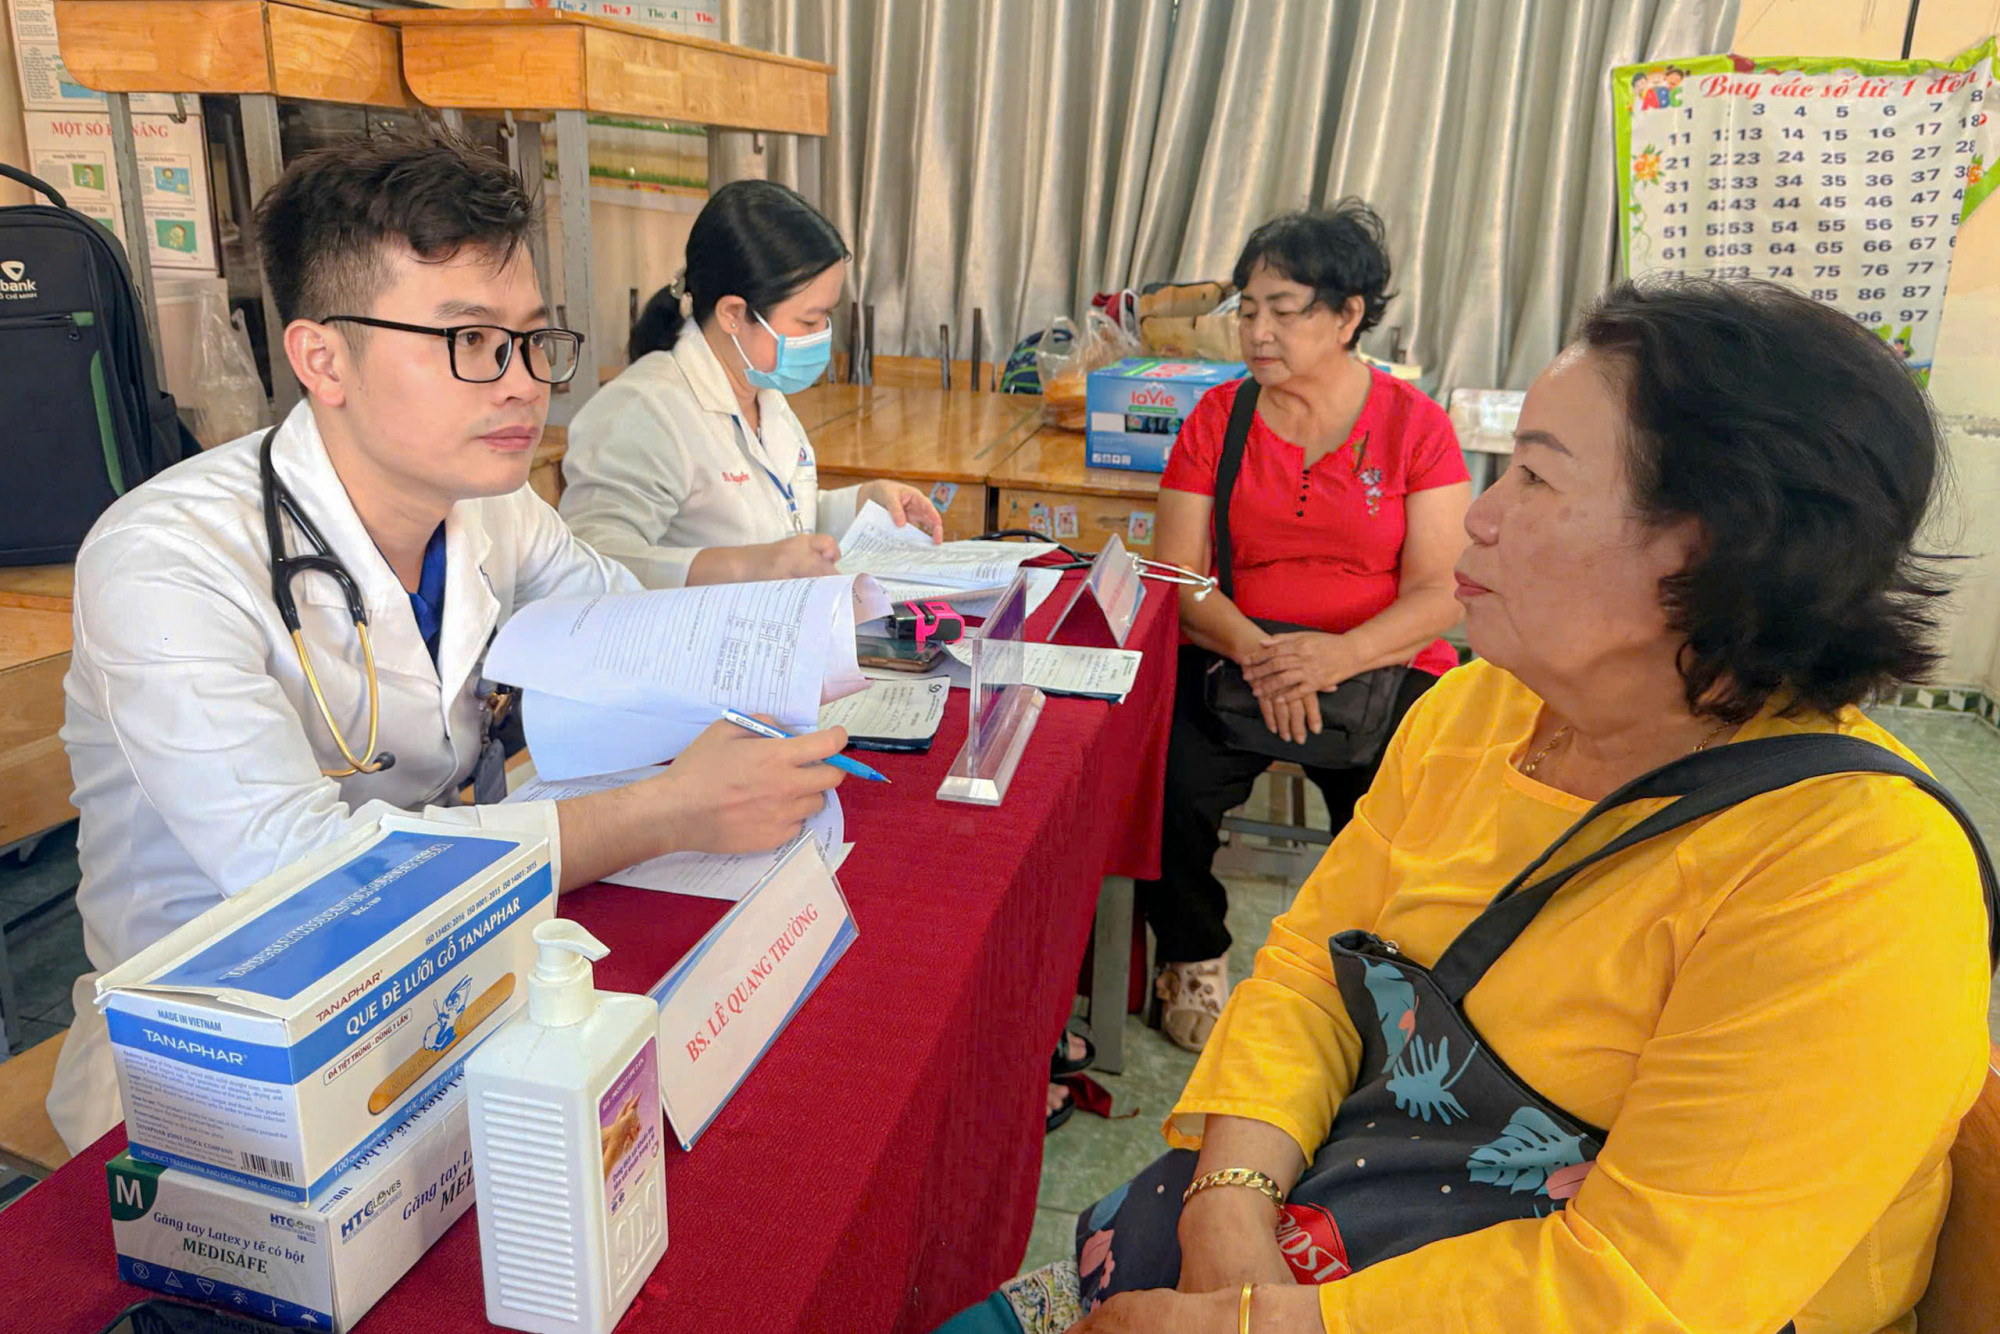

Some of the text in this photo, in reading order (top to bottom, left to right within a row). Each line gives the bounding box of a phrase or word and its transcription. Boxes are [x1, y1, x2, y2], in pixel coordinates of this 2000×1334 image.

[1641, 87, 1683, 111] ABC
[1902, 79, 1916, 97] 1
[1684, 90, 1983, 120] 1 3 4 5 6 7 8
[1669, 132, 1690, 145] 11
[1737, 128, 1762, 140] 13
[1782, 128, 1804, 139] 14
[1822, 129, 1848, 141] 15
[1869, 128, 1896, 139] 16
[1915, 122, 1942, 136] 17
[1959, 115, 1979, 128] 18
[1665, 157, 1690, 170] 21
[1733, 152, 1760, 165] 23
[1777, 151, 1804, 163] 24
[1821, 152, 1847, 164] 25
[1866, 150, 1894, 163] 26
[1911, 146, 1941, 160] 27
[1665, 181, 1689, 194] 31
[1731, 176, 1758, 189] 33
[1775, 175, 1803, 187] 34
[1821, 175, 1847, 186] 35
[1865, 174, 1894, 186] 36
[1911, 168, 1940, 183] 37
[1663, 202, 1688, 214] 41
[1730, 198, 1756, 210] 43
[1773, 197, 1800, 209] 44
[1819, 196, 1846, 208] 45
[1864, 196, 1893, 207] 46
[1910, 190, 1940, 203] 47
[1663, 226, 1687, 238] 51
[1728, 222, 1754, 234] 53
[1771, 221, 1798, 233] 54
[1817, 220, 1845, 232] 55
[1865, 219, 1893, 231] 56
[1911, 215, 1939, 228] 57
[1662, 247, 1686, 259] 61
[1726, 243, 1752, 255] 63
[1769, 243, 1796, 254] 64
[1815, 241, 1843, 254] 65
[1863, 240, 1892, 252] 66
[1909, 237, 1937, 250] 67
[1767, 266, 1793, 278] 74
[1813, 265, 1841, 278] 75
[1861, 264, 1889, 276] 76
[1907, 261, 1934, 274] 77
[1811, 288, 1838, 300] 85
[1858, 288, 1886, 300] 86
[1902, 286, 1931, 298] 87
[1856, 309, 1929, 323] 96 97
[426, 934, 434, 945] ISO
[467, 905, 475, 916] ISO
[503, 879, 511, 889] ISO
[346, 896, 521, 1036] QUE ĐÈ LƯỠI GỖ TANAPHAR
[316, 971, 381, 1023] TANAPHAR
[685, 903, 819, 1064] BS. LÊ QUANG TRƯỜNG
[158, 1010, 222, 1032] MADE IN VIETNAM
[142, 1028, 244, 1066] TANAPHAR
[115, 1175, 144, 1209] M
[403, 1182, 437, 1220] Găng
[441, 1160, 460, 1186] tay
[153, 1211, 305, 1264] Găng tay Latex y tế có bột
[183, 1238, 268, 1274] MEDISAFE
